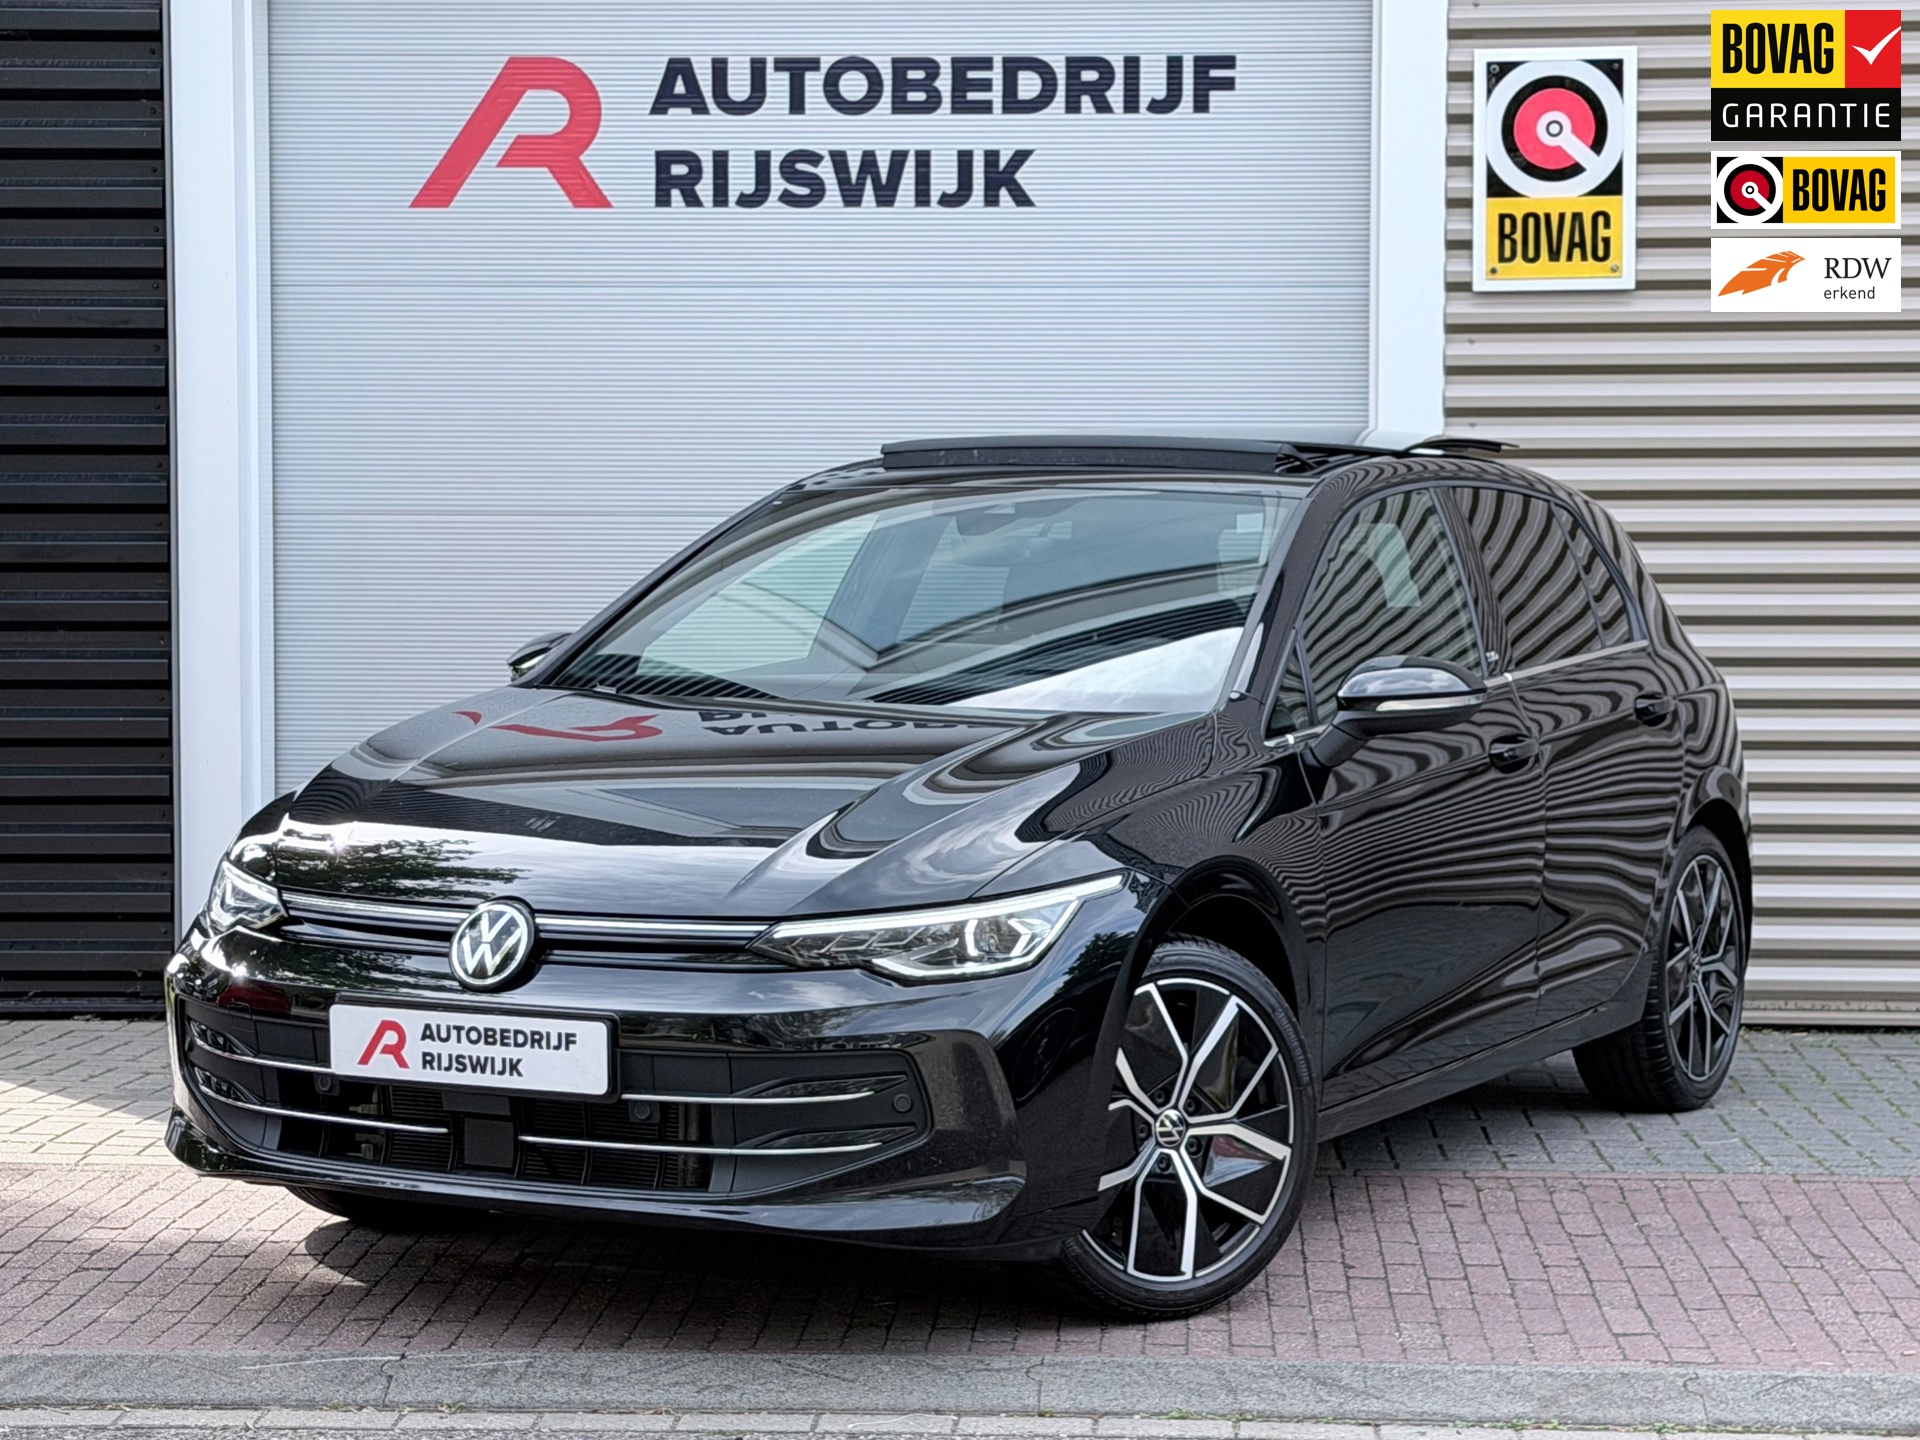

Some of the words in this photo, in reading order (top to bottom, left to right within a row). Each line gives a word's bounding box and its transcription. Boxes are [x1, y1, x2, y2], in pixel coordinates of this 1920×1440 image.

[649, 55, 1237, 116] AUTOBEDRIJF
[654, 149, 1036, 208] RIJSWIJK
[1498, 211, 1612, 264] BOVAG
[420, 1022, 578, 1052] AUTOBEDRIJF
[421, 1051, 524, 1078] RIJSWIJK
